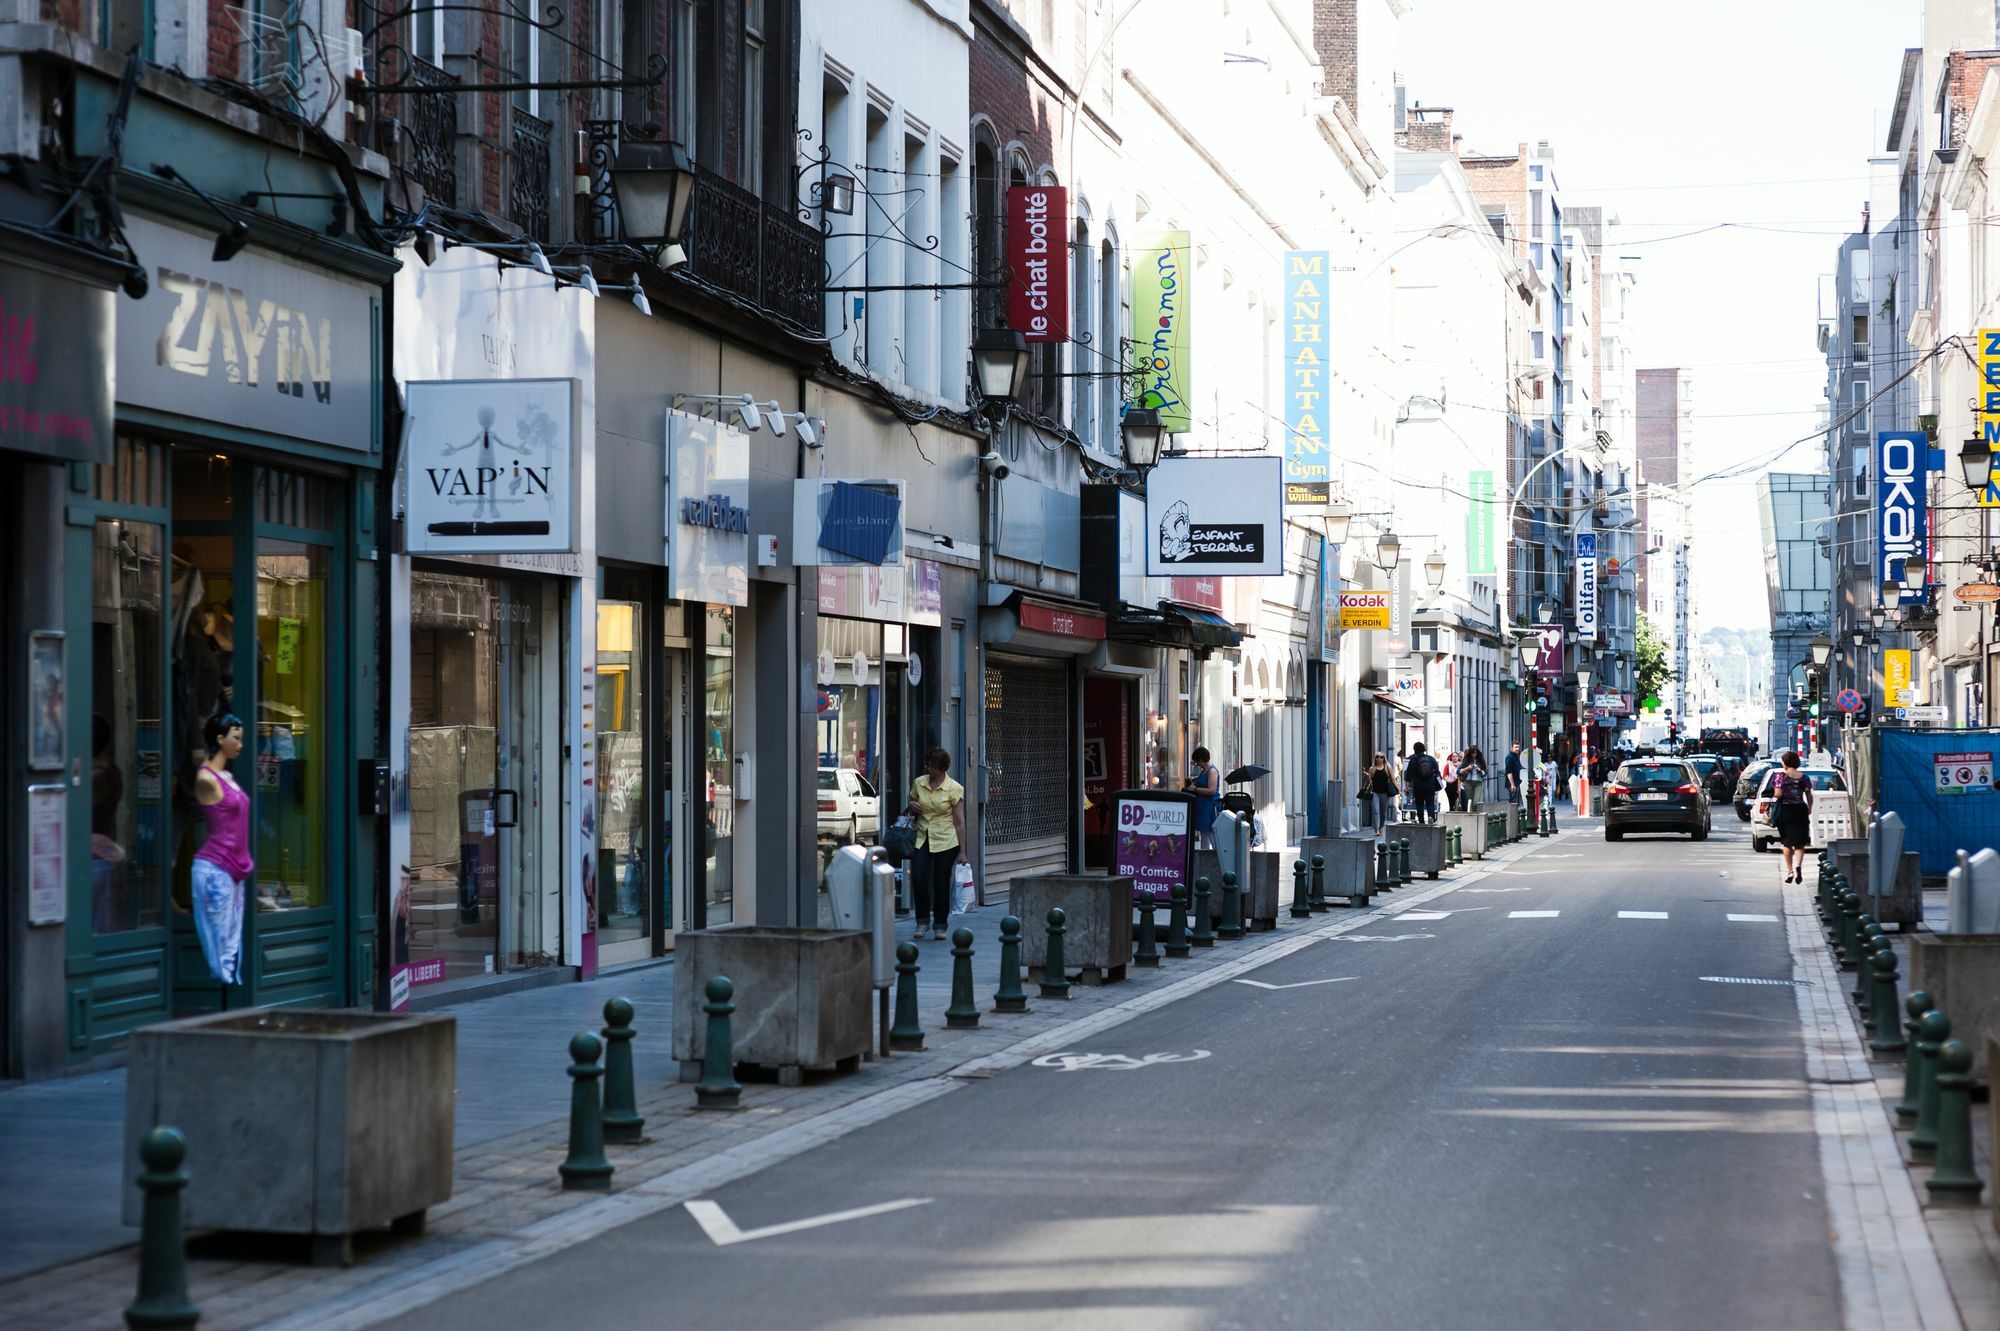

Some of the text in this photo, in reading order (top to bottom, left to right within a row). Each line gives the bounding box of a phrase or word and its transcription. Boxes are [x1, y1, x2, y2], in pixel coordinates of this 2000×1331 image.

[1024, 192, 1048, 336] le chat botté
[1290, 255, 1324, 456] MANHATTAN
[1287, 461, 1328, 480] Gym
[1287, 493, 1328, 502] William
[1191, 530, 1244, 541] ENFANT
[1340, 594, 1385, 607] Kodak
[1343, 619, 1382, 627] E. VERDIN
[1121, 804, 1185, 827] BD-WORLD
